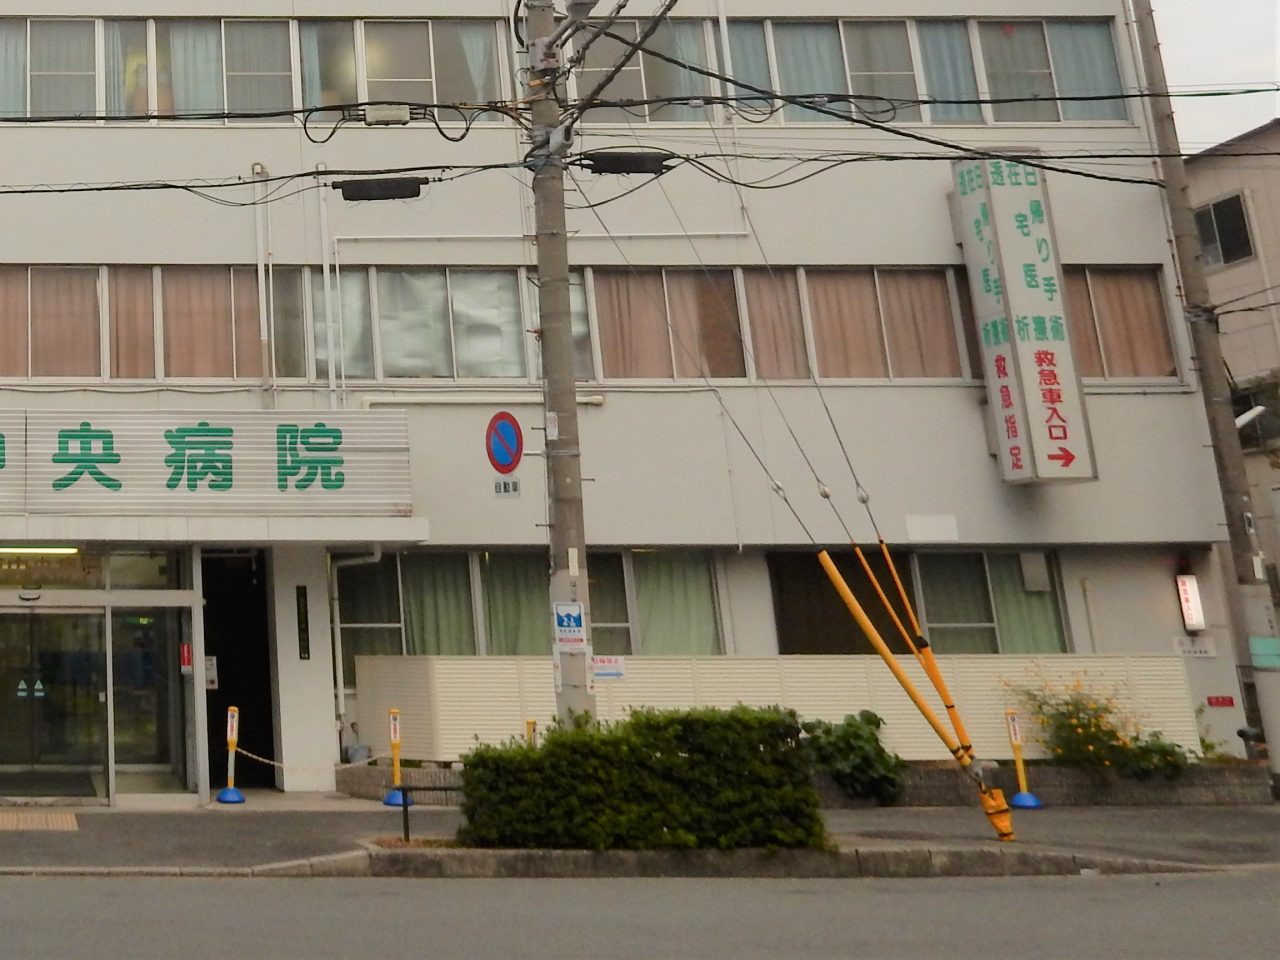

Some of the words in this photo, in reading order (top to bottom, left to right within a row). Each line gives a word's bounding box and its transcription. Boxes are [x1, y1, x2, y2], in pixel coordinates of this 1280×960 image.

[994, 354, 1024, 471] 救急指定
[1034, 349, 1068, 441] 救急車入口
